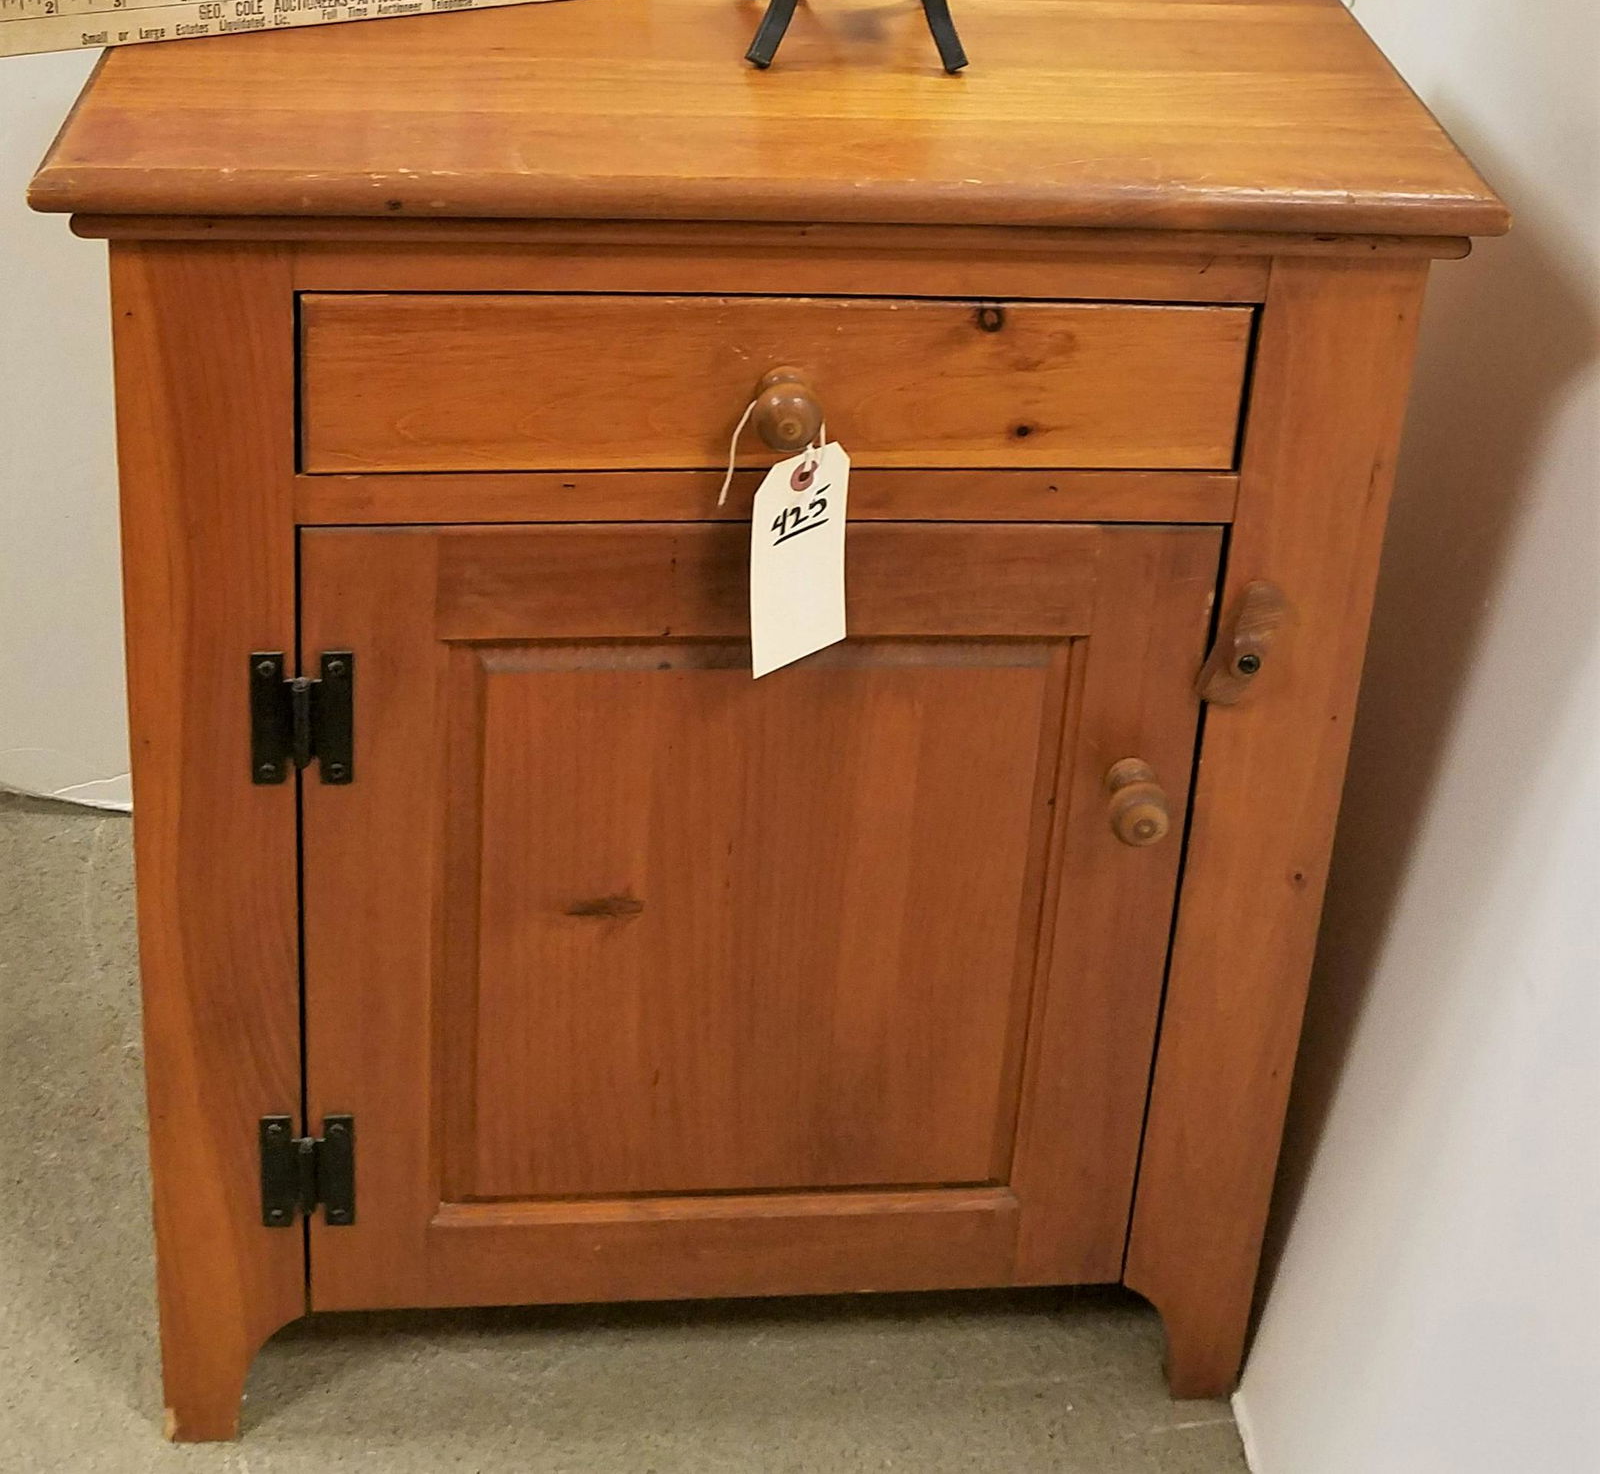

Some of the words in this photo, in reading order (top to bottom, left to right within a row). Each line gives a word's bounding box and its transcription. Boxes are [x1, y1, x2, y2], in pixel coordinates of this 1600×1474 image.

[45, 1, 55, 14] 2
[235, 0, 264, 16] COLE
[82, 32, 108, 45] Small
[118, 30, 129, 41] or
[139, 27, 166, 39] Large
[175, 23, 208, 35] Estates
[770, 483, 831, 540] 425
